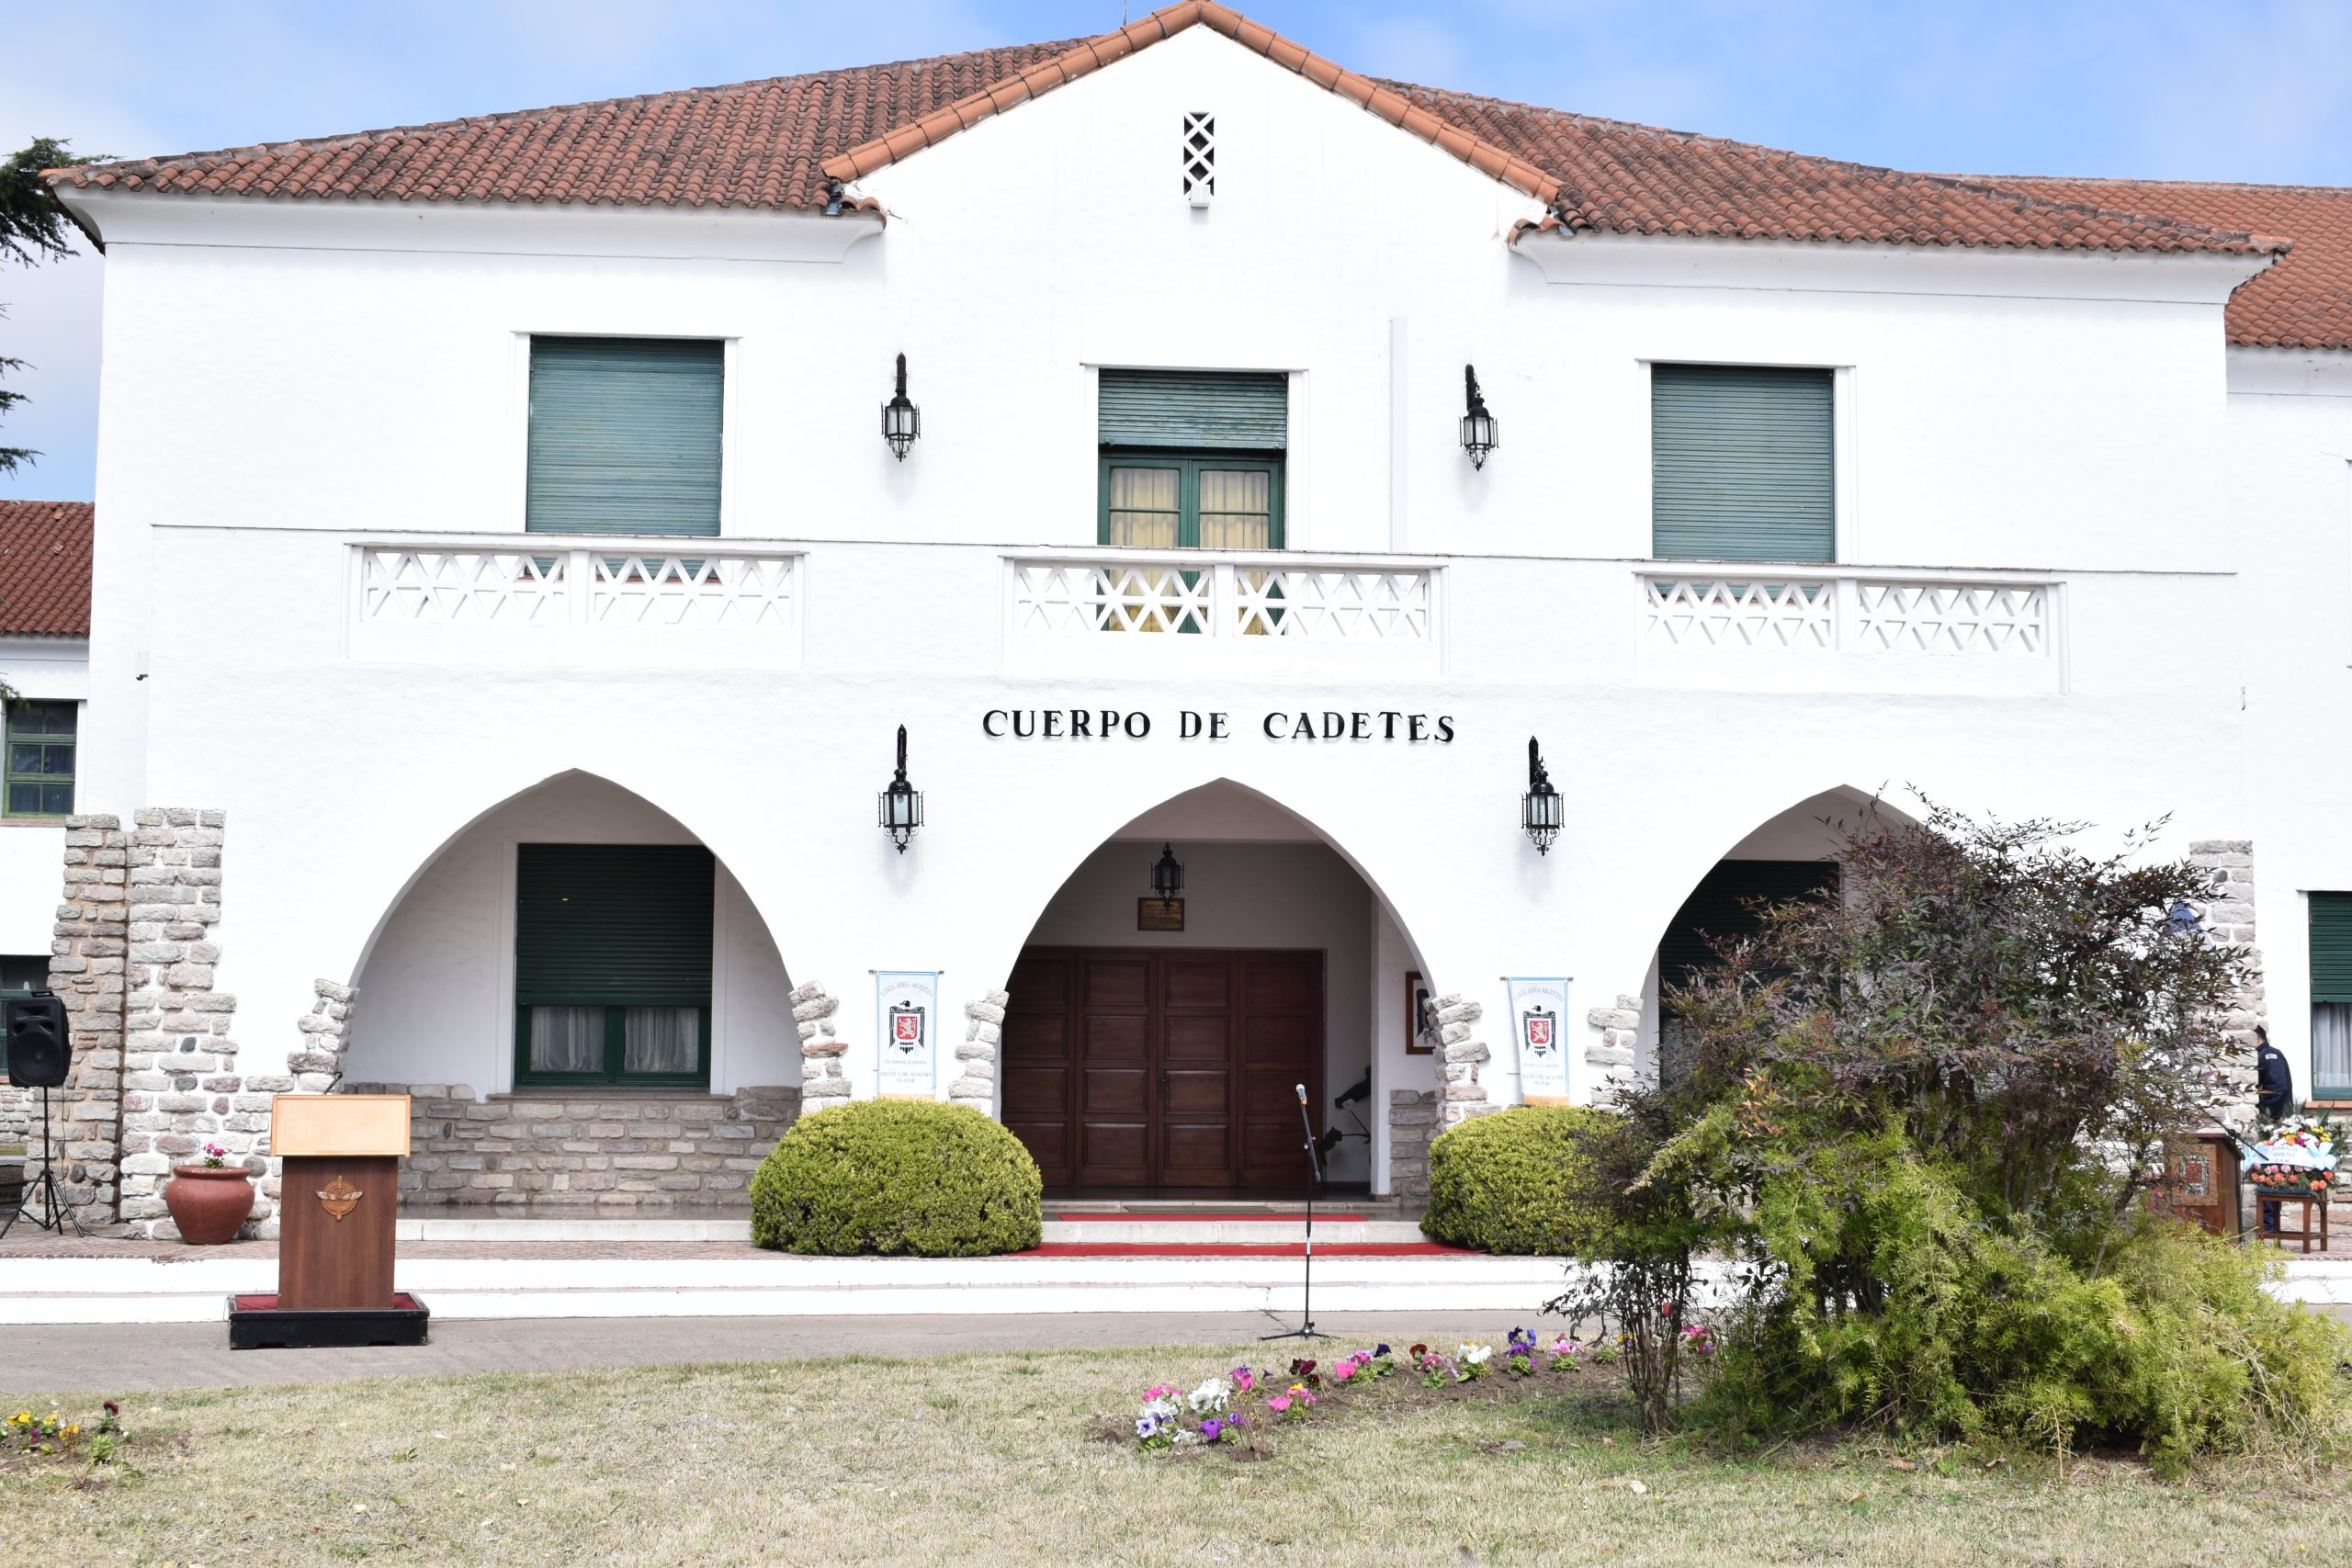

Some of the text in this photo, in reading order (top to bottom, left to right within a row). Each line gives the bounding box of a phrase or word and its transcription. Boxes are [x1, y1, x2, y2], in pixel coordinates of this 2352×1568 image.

[982, 709, 1454, 743] CUERPO DE CADETES
